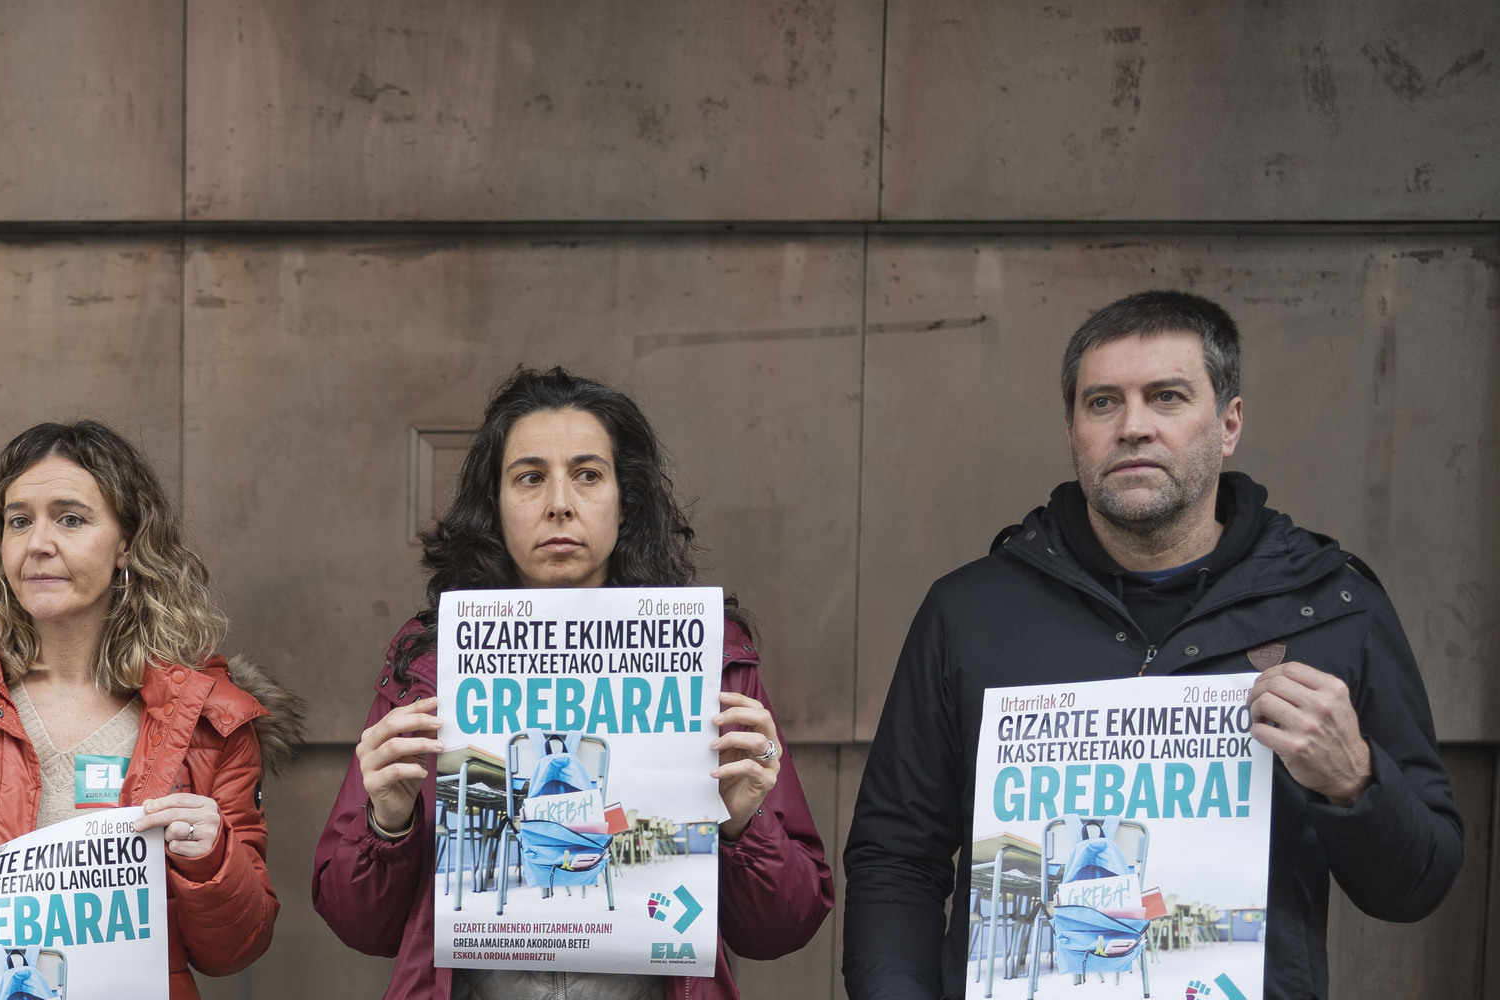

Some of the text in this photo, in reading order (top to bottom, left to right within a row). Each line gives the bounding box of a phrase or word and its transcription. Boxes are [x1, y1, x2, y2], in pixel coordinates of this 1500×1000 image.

[457, 601, 532, 617] Urtarrilak 20
[638, 598, 704, 616] 20 de enero
[456, 619, 704, 650] GIZARTE EKIMENEKO
[458, 652, 703, 674] IKASTETXEETAKO LANGILEOK
[456, 676, 703, 734] GREBARA!
[1001, 693, 1075, 713] Urtarrilak 20
[1183, 687, 1251, 703] 20 de ener
[998, 705, 1252, 742] GIZARTE EKIMENEKO
[997, 737, 1252, 764] IKASTETXEETAKO LANGILEOK
[86, 764, 125, 789] EL
[993, 761, 1252, 823] GREBARA!
[533, 794, 593, 823] GREBA!
[85, 819, 134, 836] 20 de ene
[23, 836, 148, 871] EKIMENEKO
[60, 866, 148, 890] LANGILEOK
[1068, 879, 1131, 908] GREBA!
[454, 923, 612, 934] GIZARTE EKIMENEKO HITZARMENA ORAIN!
[453, 939, 590, 948] GREBA AMAIERAKO AKORDIOA BETE!
[651, 943, 696, 959] ELA
[453, 952, 555, 961] ESKOLA ORDUA MURRIZTU!
